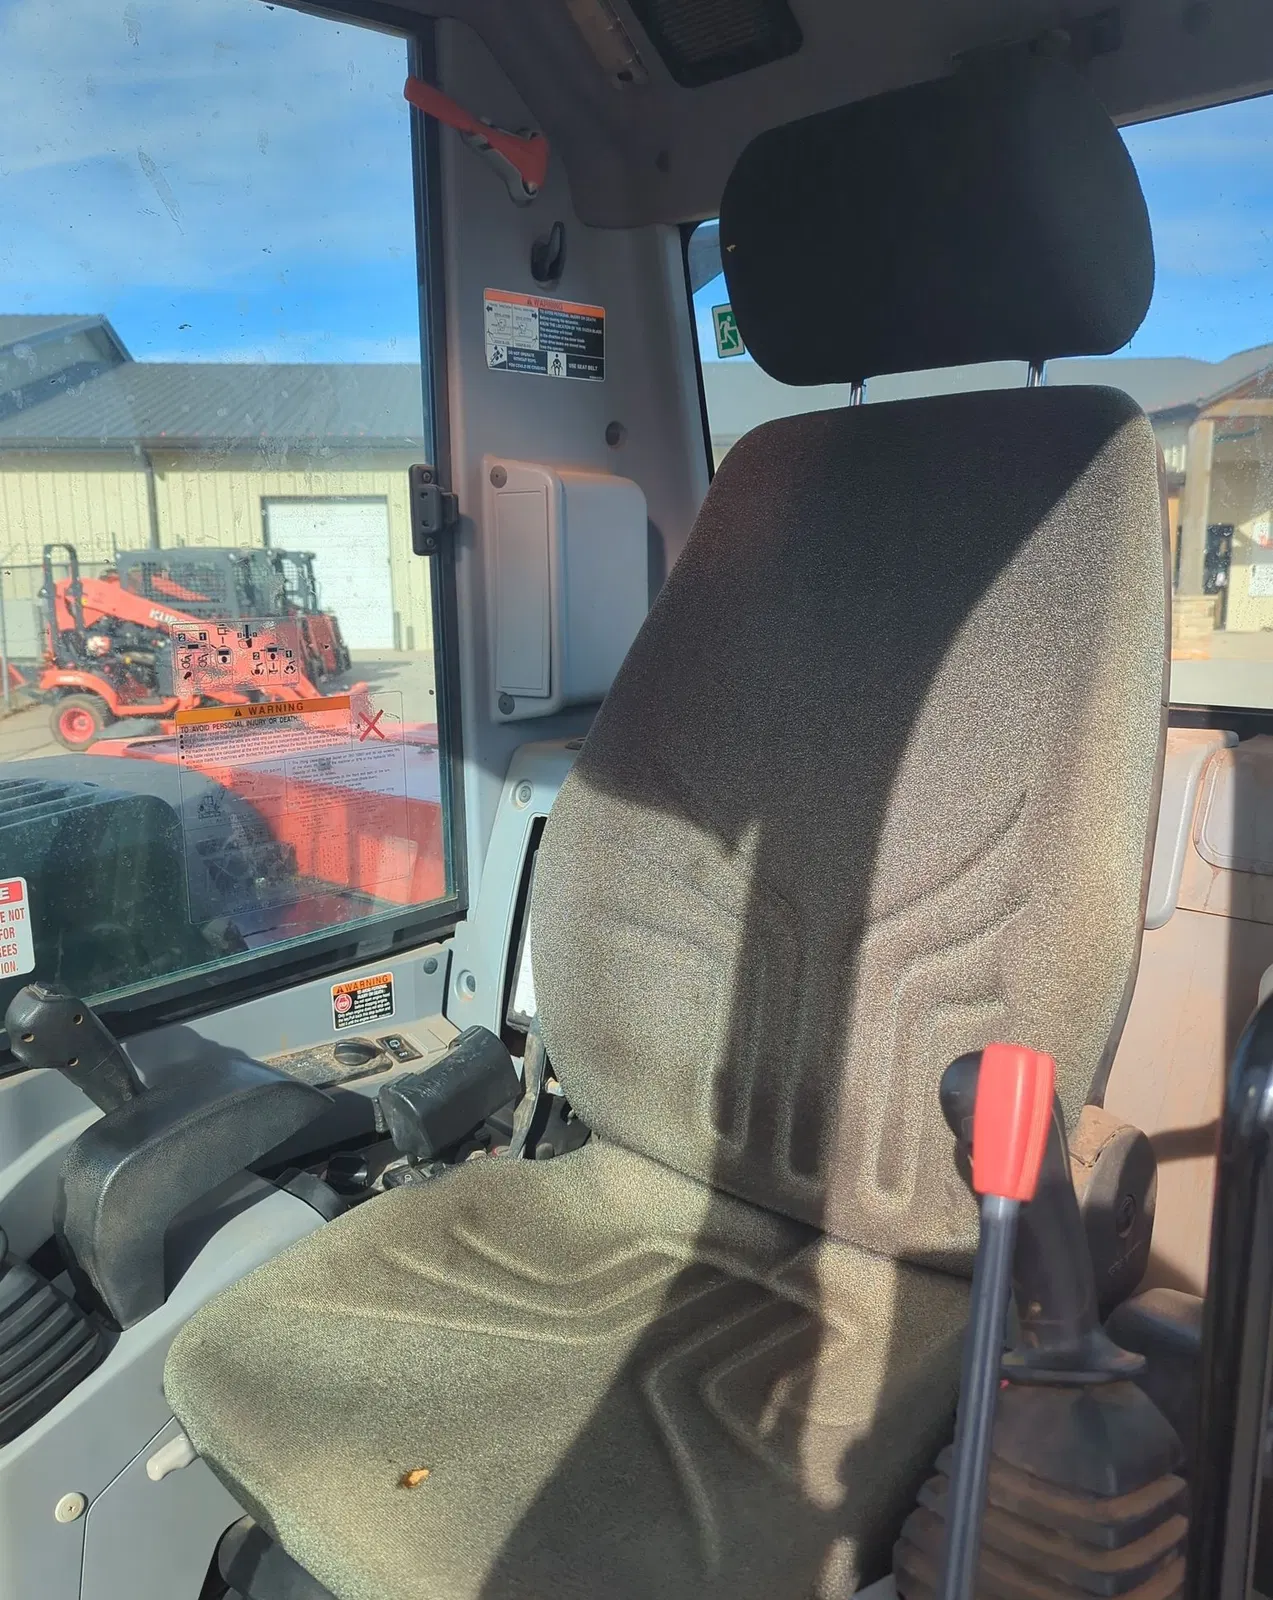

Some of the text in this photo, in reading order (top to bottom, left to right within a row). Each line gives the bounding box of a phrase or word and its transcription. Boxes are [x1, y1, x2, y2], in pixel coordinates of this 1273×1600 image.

[248, 702, 304, 715] WARNING
[213, 721, 243, 730] PERSONAL
[246, 718, 266, 726] INJURY
[8, 908, 25, 921] NOT
[0, 927, 15, 940] FOR
[345, 975, 388, 992] WARNING
